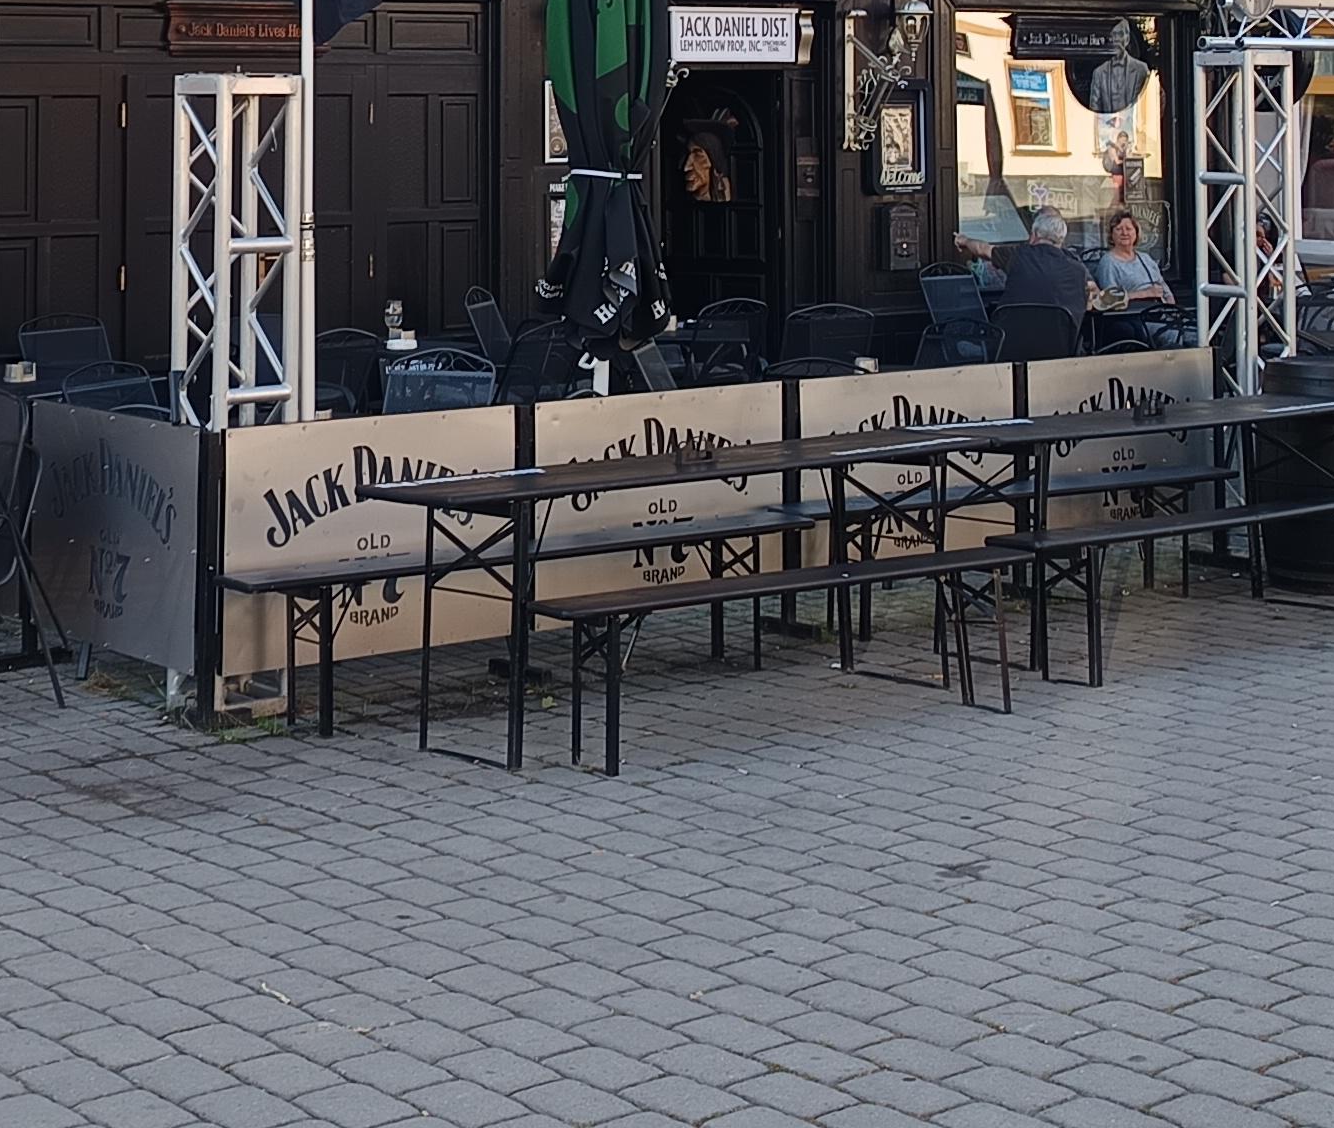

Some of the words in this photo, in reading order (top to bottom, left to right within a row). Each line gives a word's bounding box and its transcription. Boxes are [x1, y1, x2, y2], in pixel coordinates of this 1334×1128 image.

[188, 22, 212, 37] Jack
[258, 23, 286, 38] Lives
[679, 16, 711, 37] JACK
[715, 16, 757, 37] DANIEL
[761, 17, 789, 38] DIST.
[680, 39, 693, 52] LEM
[695, 40, 725, 52] MOTLOW
[748, 40, 762, 52] INC.
[1113, 446, 1135, 461] OLD
[897, 470, 923, 485] OLD
[98, 437, 177, 546] DANIEL'S
[263, 463, 351, 548] JACK
[648, 498, 677, 514] OLD
[100, 529, 120, 546] OLD
[357, 533, 391, 551] OLD
[642, 565, 686, 584] BRAND
[94, 599, 123, 620] BRAND
[349, 606, 399, 627] BRAND
